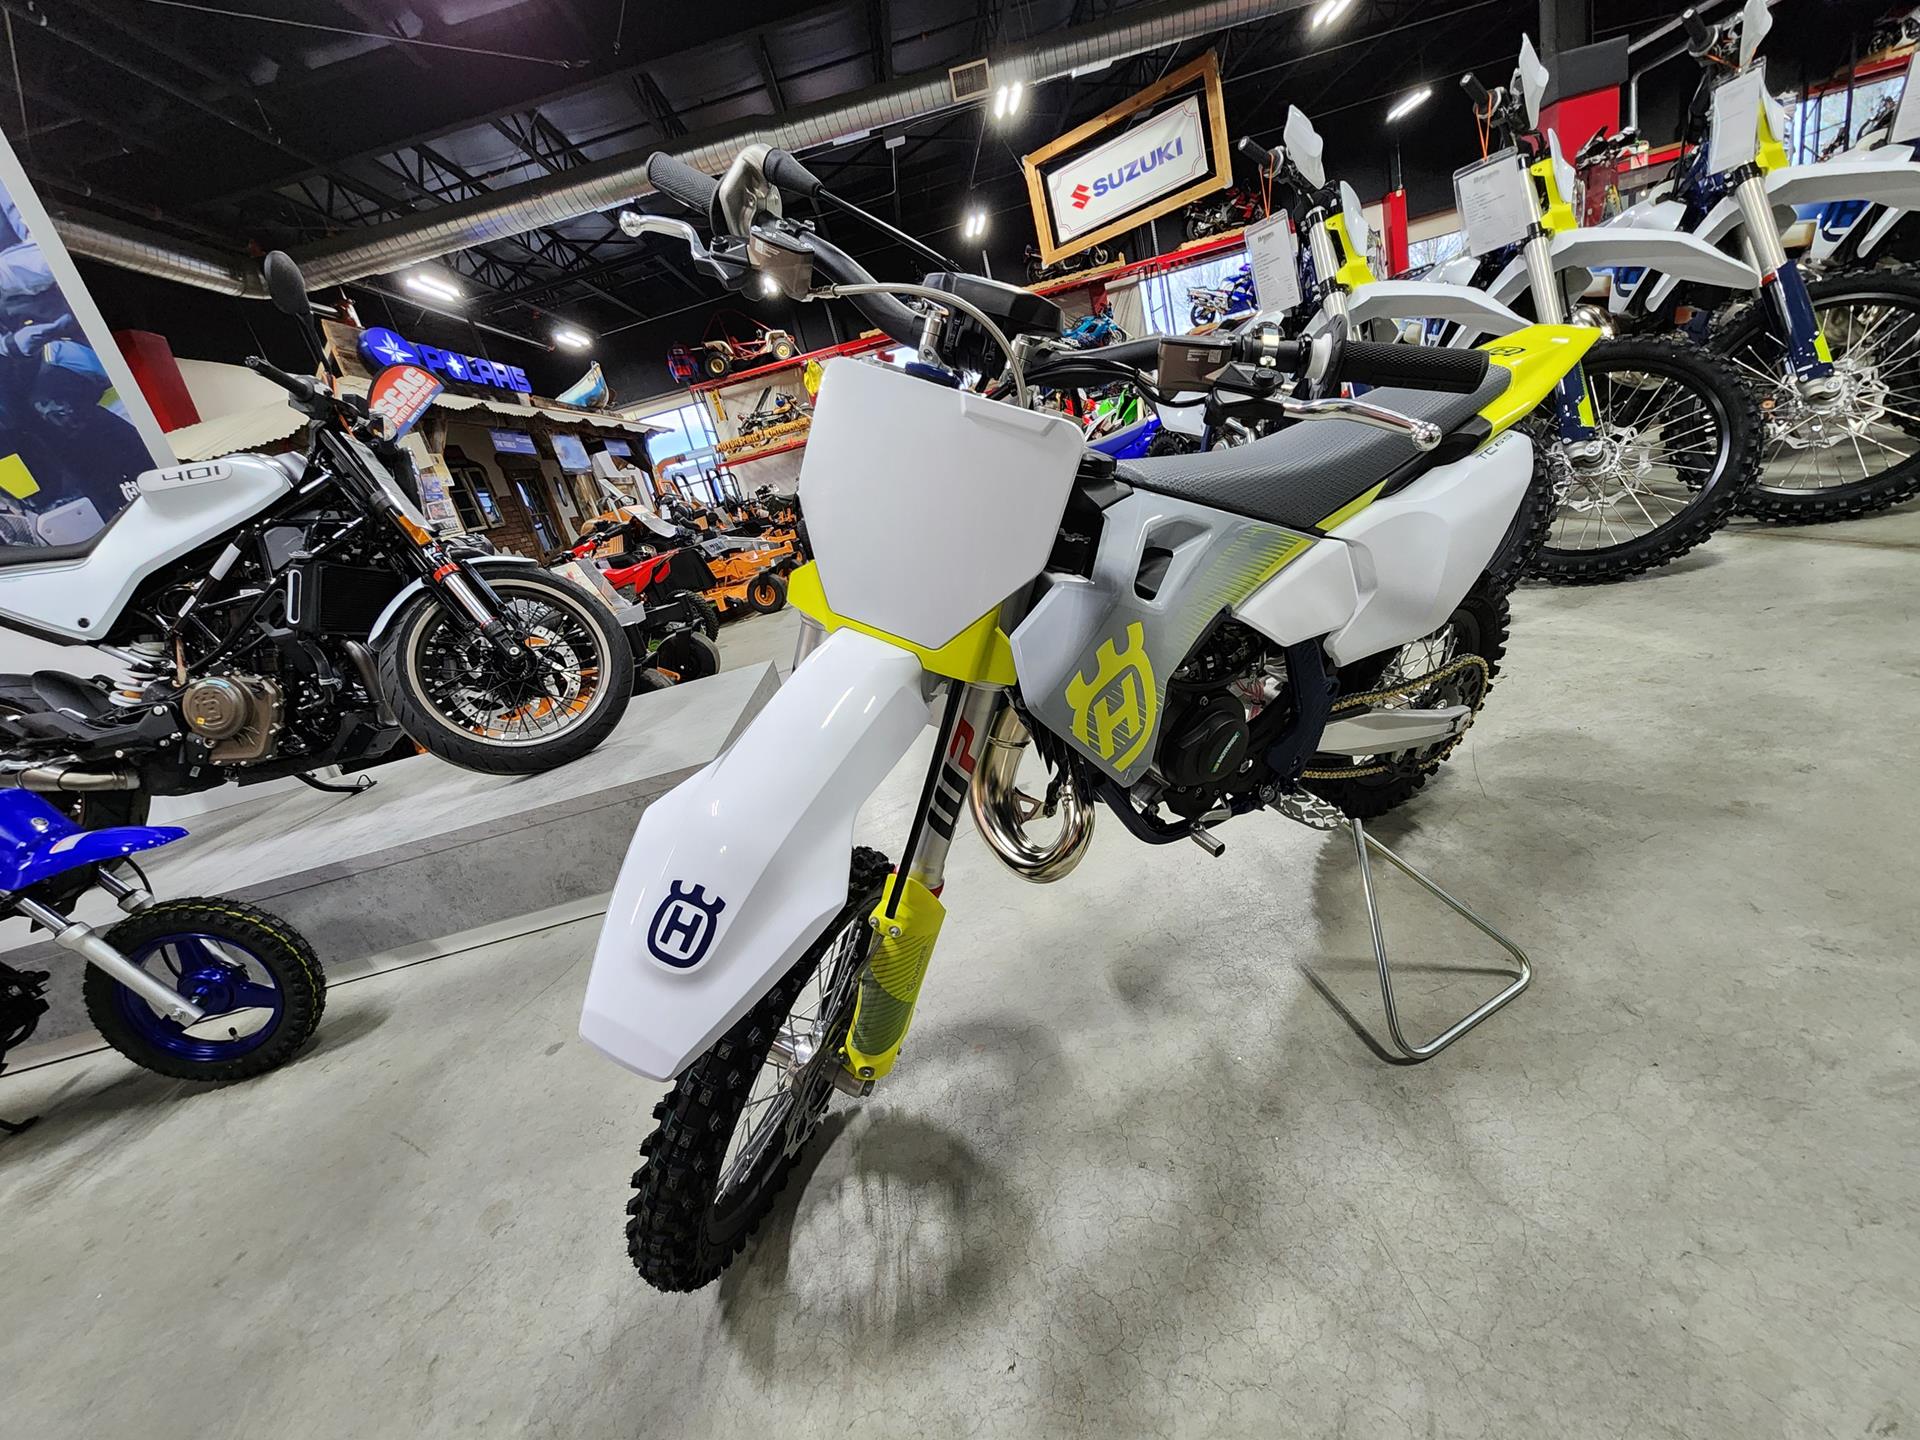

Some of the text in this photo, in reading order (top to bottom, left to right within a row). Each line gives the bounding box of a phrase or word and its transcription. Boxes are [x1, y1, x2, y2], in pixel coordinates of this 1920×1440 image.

[1092, 136, 1184, 198] SUZUKI
[374, 367, 427, 417] SCAG
[417, 345, 532, 394] POLARIS
[161, 465, 221, 482] 401
